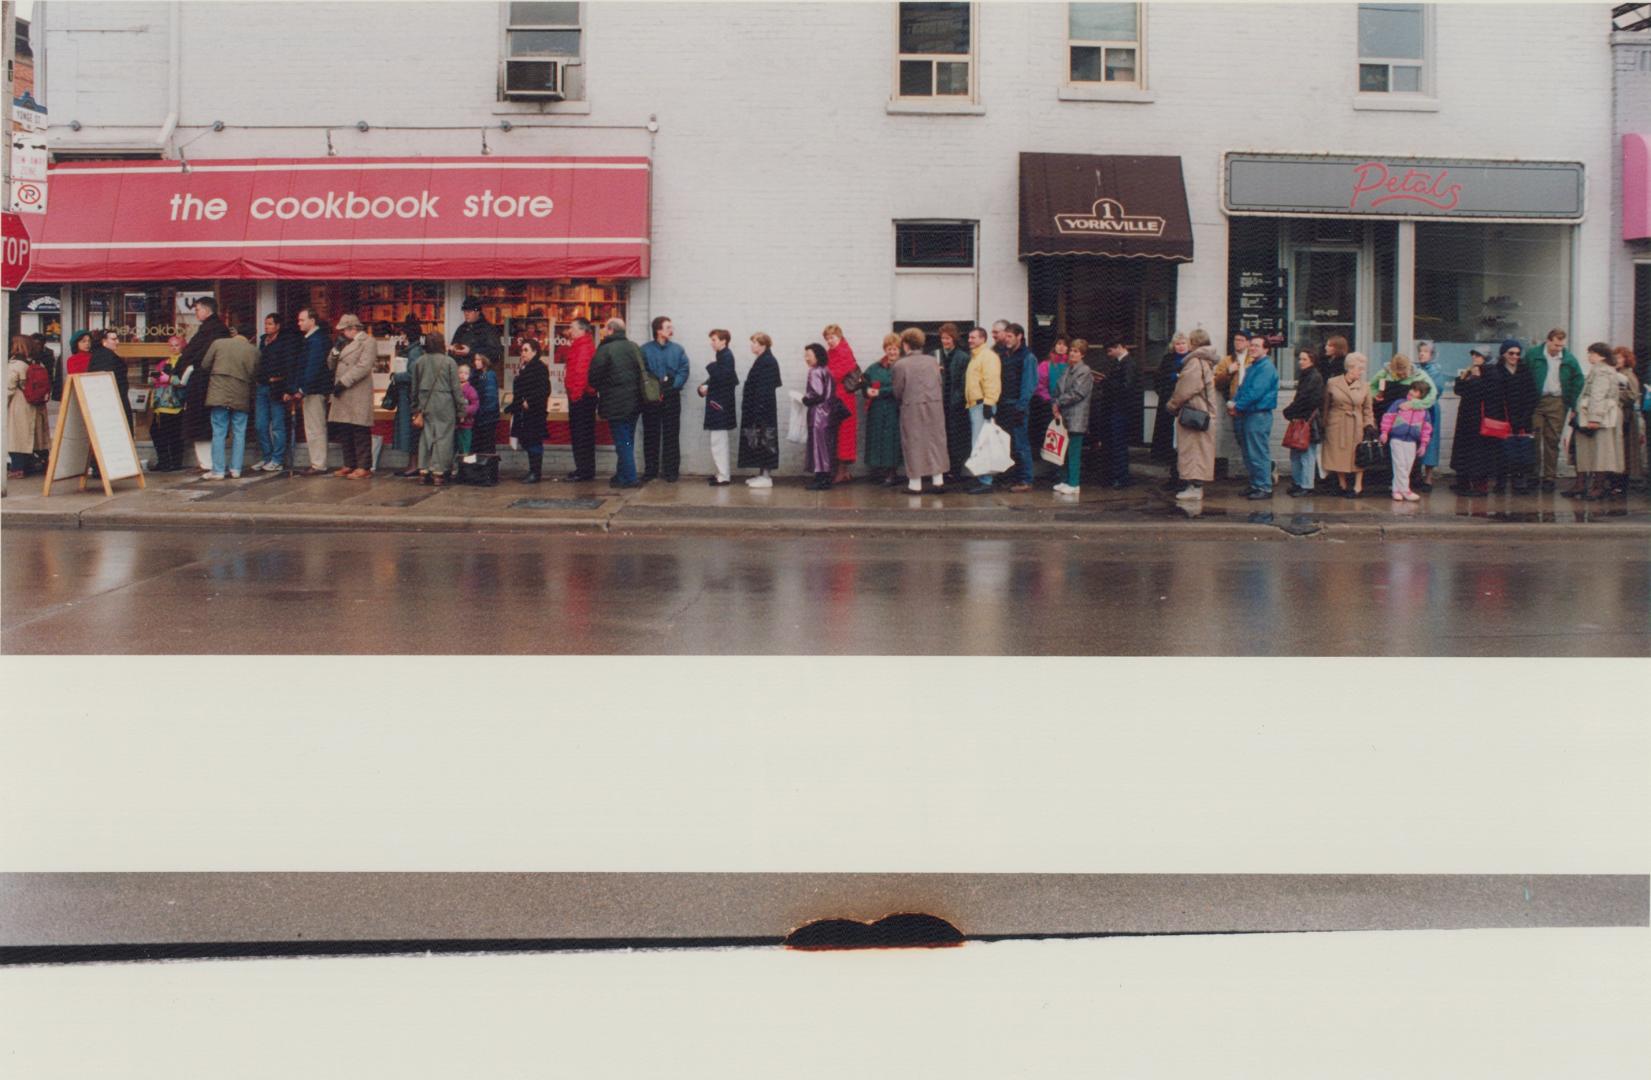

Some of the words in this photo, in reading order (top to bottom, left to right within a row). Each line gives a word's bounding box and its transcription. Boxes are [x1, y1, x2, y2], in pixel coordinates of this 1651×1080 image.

[1350, 161, 1464, 210] Petals
[170, 193, 228, 220] the
[250, 190, 439, 219] cookbook
[463, 190, 554, 218] store
[1102, 202, 1115, 219] 1
[1064, 218, 1160, 232] YORKVILLE
[1, 236, 30, 266] TOP
